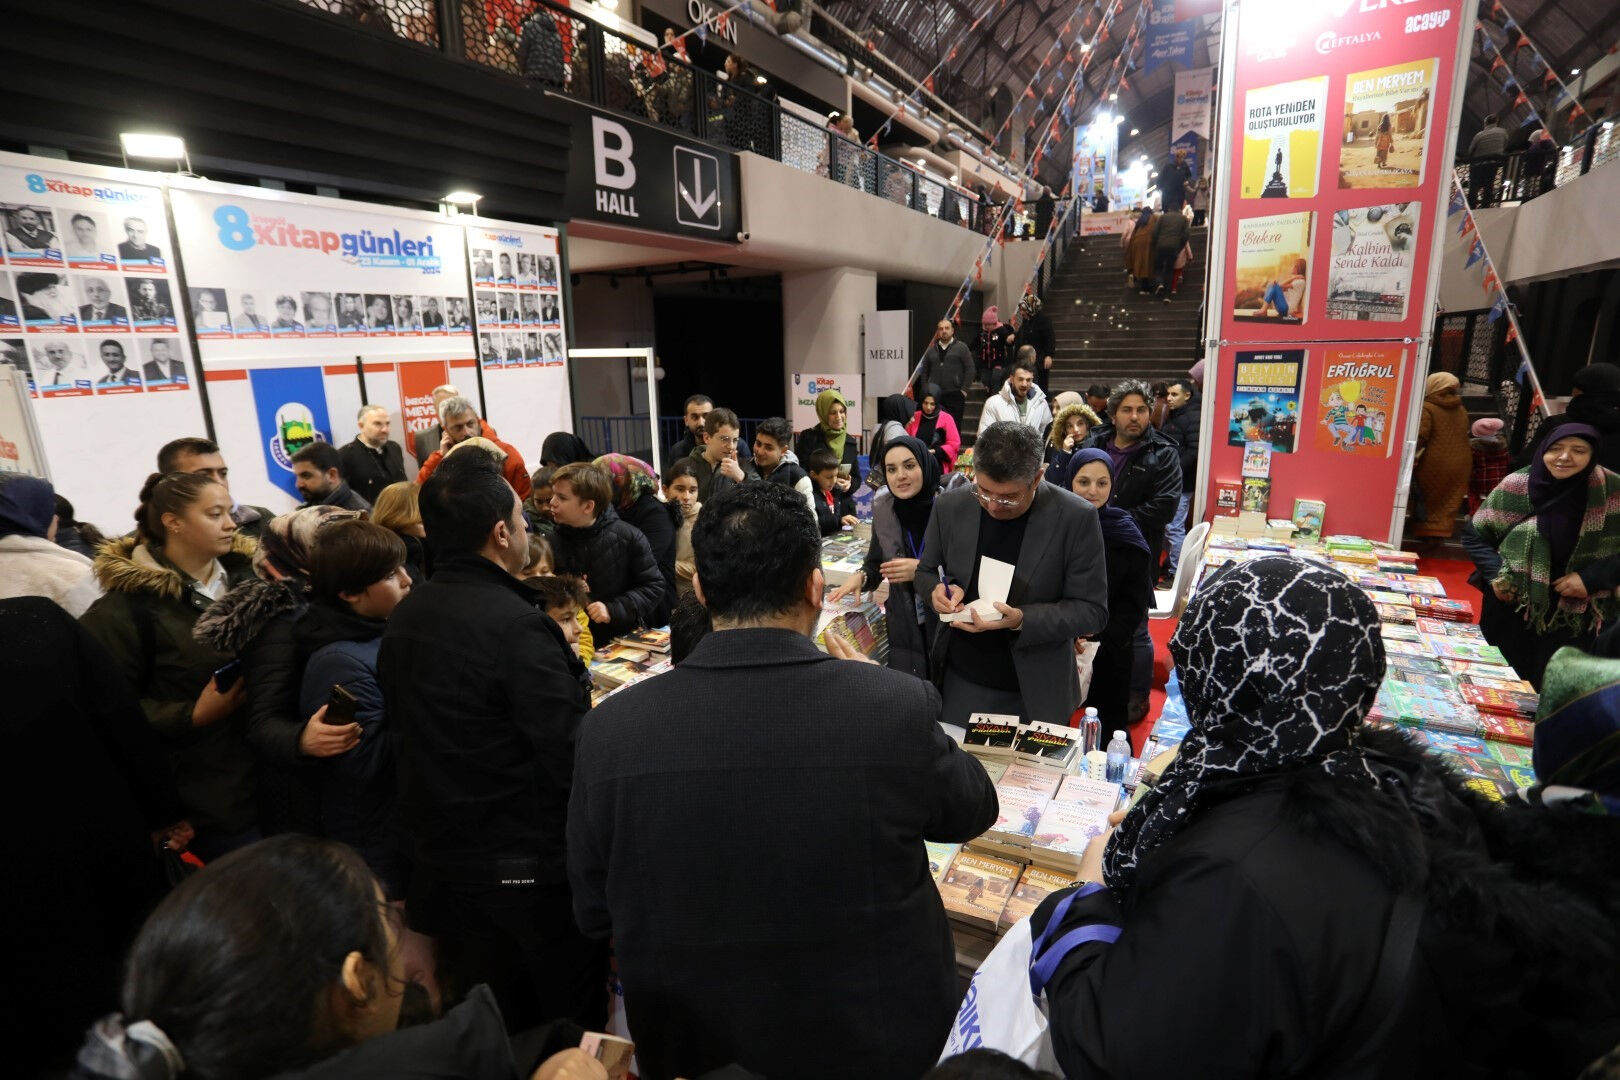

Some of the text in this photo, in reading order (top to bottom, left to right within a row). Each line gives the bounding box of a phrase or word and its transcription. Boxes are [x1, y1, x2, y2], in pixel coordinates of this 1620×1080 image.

[688, 0, 738, 45] OKAN
[1405, 9, 1451, 34] acayip
[1353, 70, 1425, 95] BEN MERYEM
[1249, 113, 1316, 131] OLUŞTURULUYOR
[1250, 106, 1272, 119] ROTA
[592, 115, 637, 190] B
[25, 173, 47, 194] 8
[595, 189, 640, 218] HALL
[213, 204, 256, 251] 8
[341, 227, 434, 257] günleri
[1334, 254, 1368, 269] Sende
[870, 347, 904, 360] MERLİ
[1327, 362, 1395, 379] ERTUĞRUL
[808, 381, 817, 394] 8
[405, 406, 436, 417] MEVS
[961, 856, 1013, 875] BEN MERYEM
[1030, 869, 1047, 878] BEN
